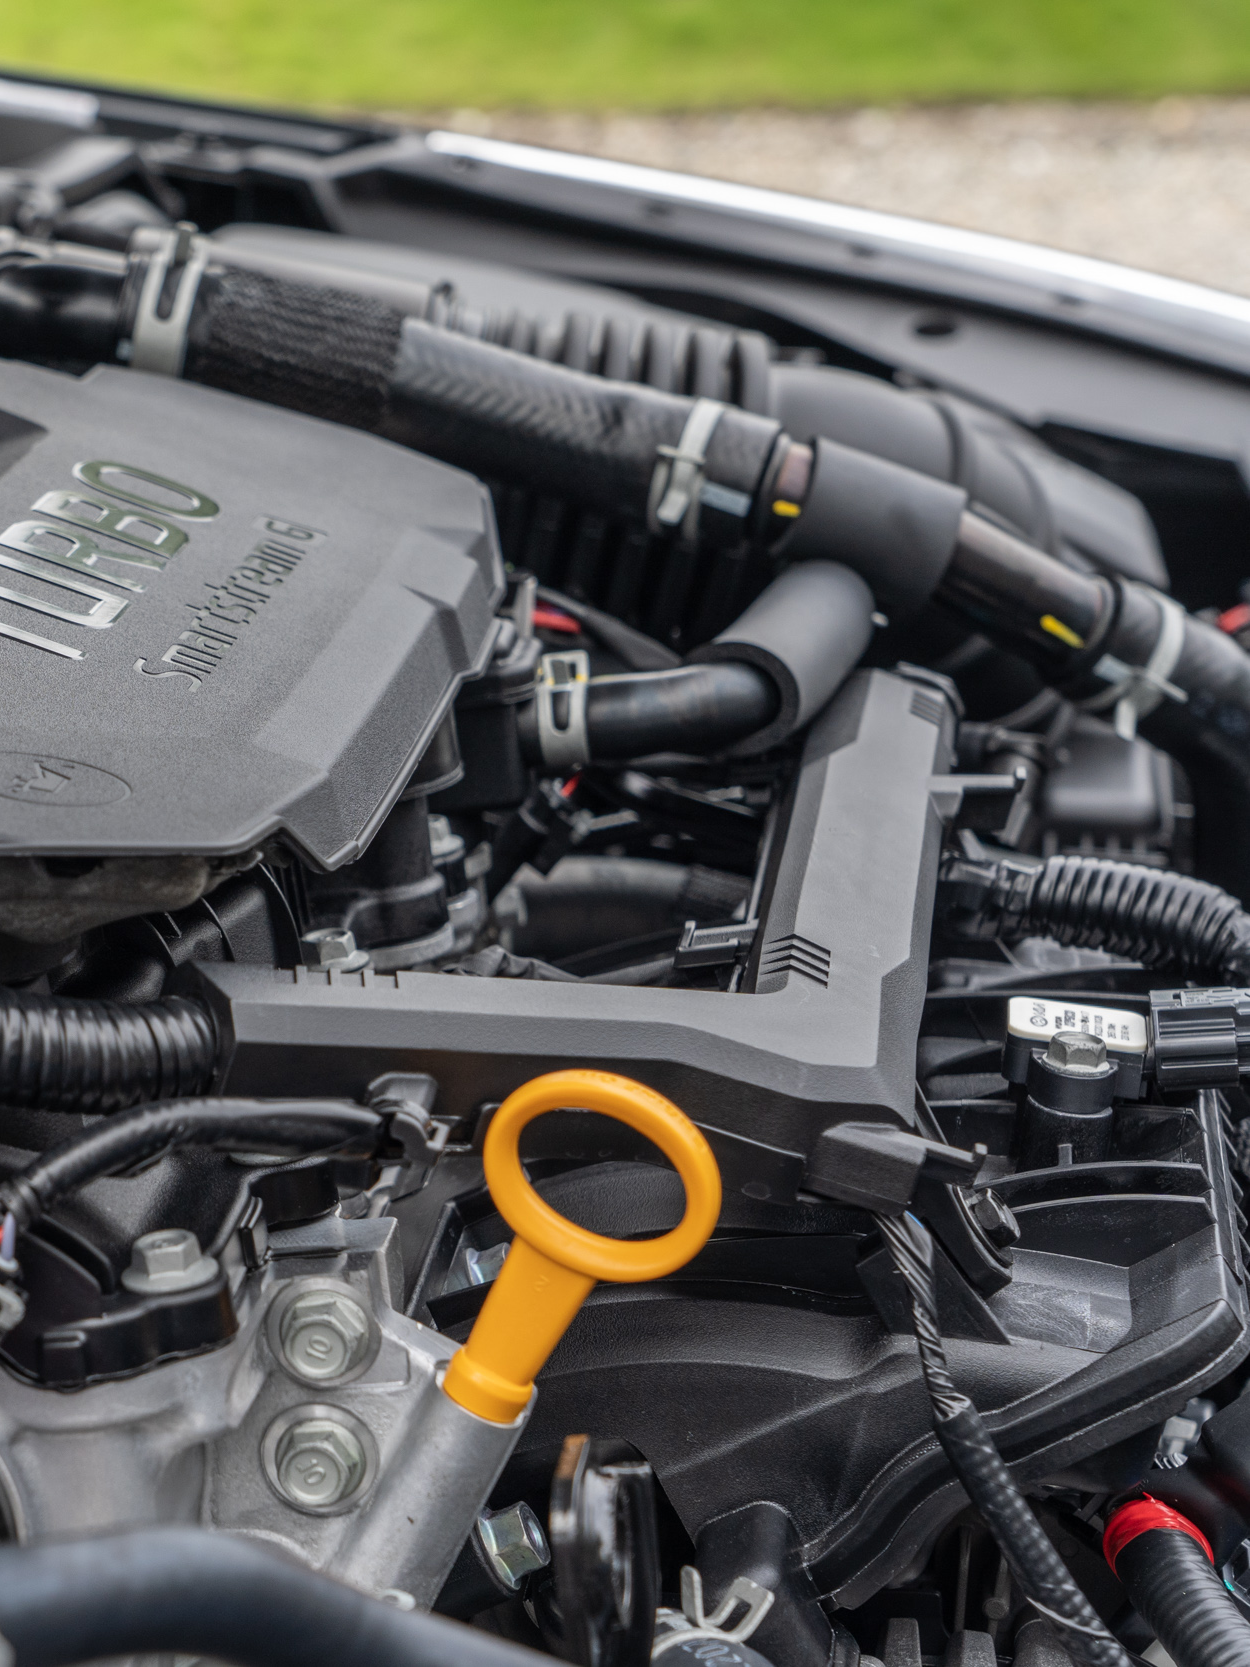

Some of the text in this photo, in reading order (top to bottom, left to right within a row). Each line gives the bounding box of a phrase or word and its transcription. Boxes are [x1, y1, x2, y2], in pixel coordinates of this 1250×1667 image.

[133, 538, 307, 693] Smartstream
[305, 1334, 333, 1361] 10
[295, 1458, 327, 1487] 10
